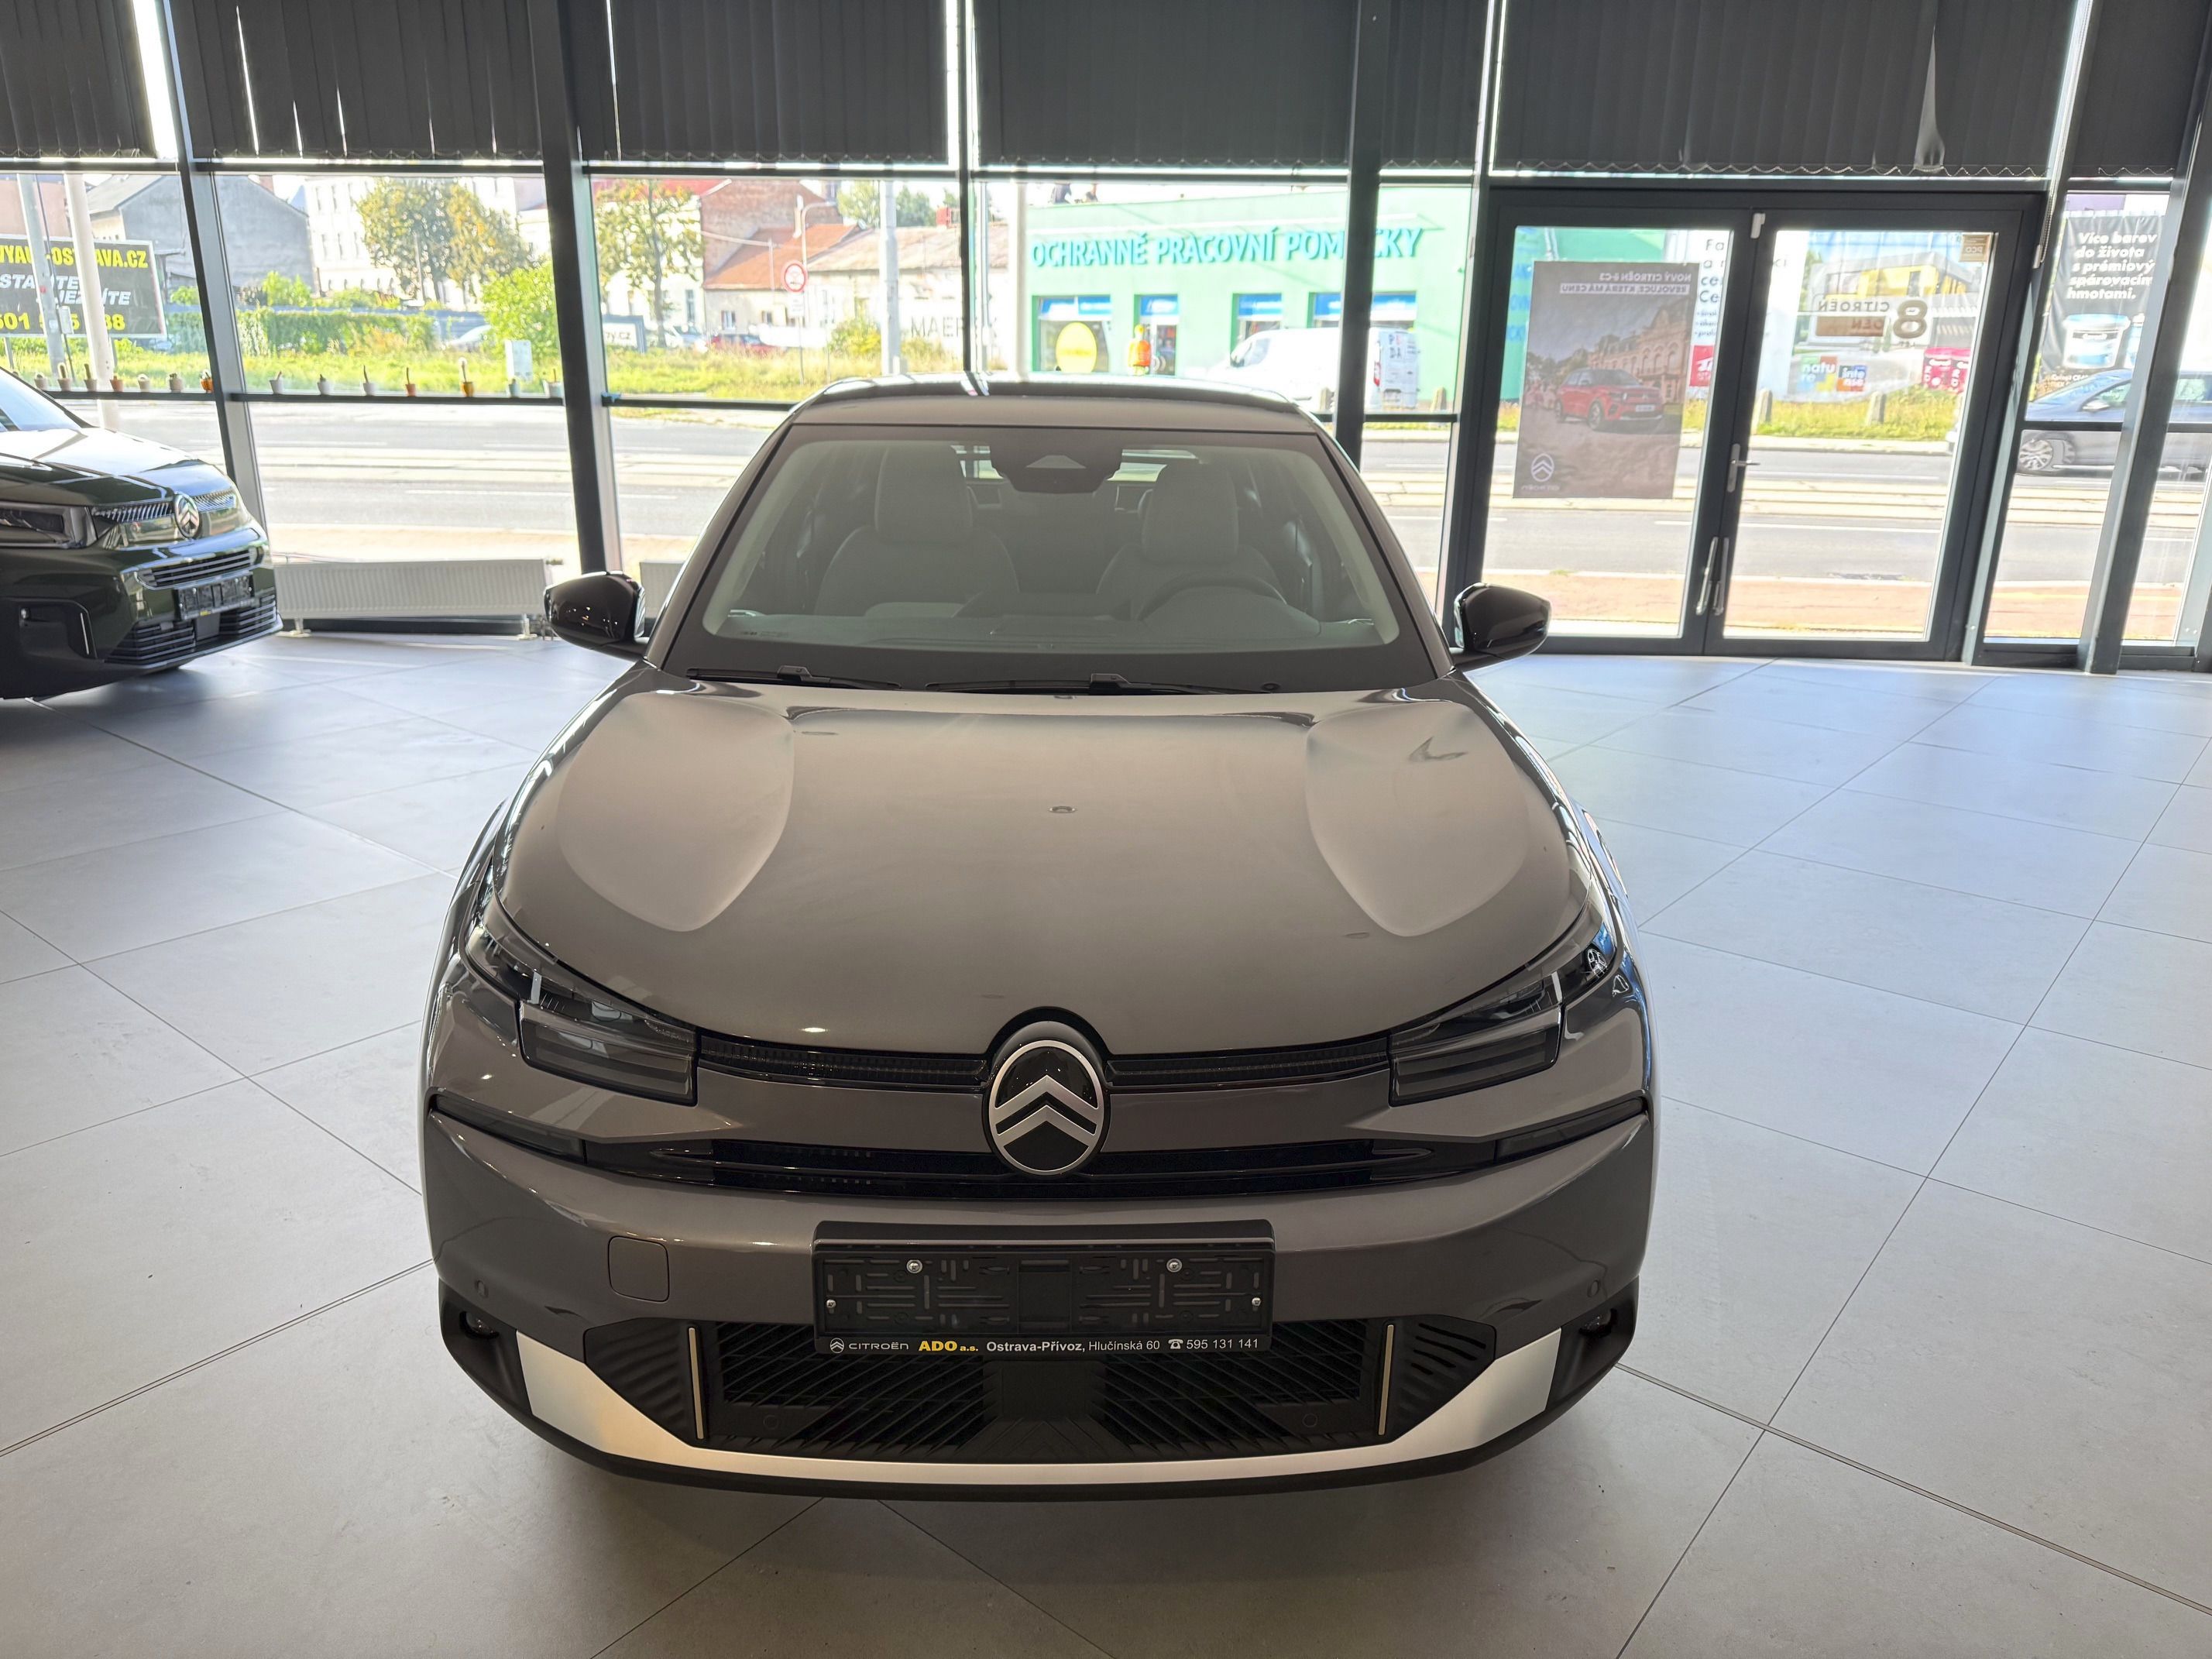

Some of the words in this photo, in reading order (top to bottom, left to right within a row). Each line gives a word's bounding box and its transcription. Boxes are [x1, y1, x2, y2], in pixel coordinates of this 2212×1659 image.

[2079, 232, 2109, 244] Více
[2111, 231, 2157, 244] barev
[1032, 232, 1149, 267] OCHRANNÉ
[1156, 227, 1279, 265] PRACOVNÍ
[1284, 228, 1424, 260] POMKY
[2075, 246, 2095, 258] do
[2097, 245, 2145, 258] života
[849, 1341, 909, 1350] CITROËN
[919, 1341, 957, 1352] ADO
[986, 1341, 1085, 1352] Ostrava-Přívoz,
[1088, 1340, 1142, 1351] Hlučínská
[1146, 1340, 1160, 1350] 60
[1186, 1339, 1208, 1349] 595
[1213, 1338, 1233, 1349] 131
[1238, 1338, 1259, 1348] 141
